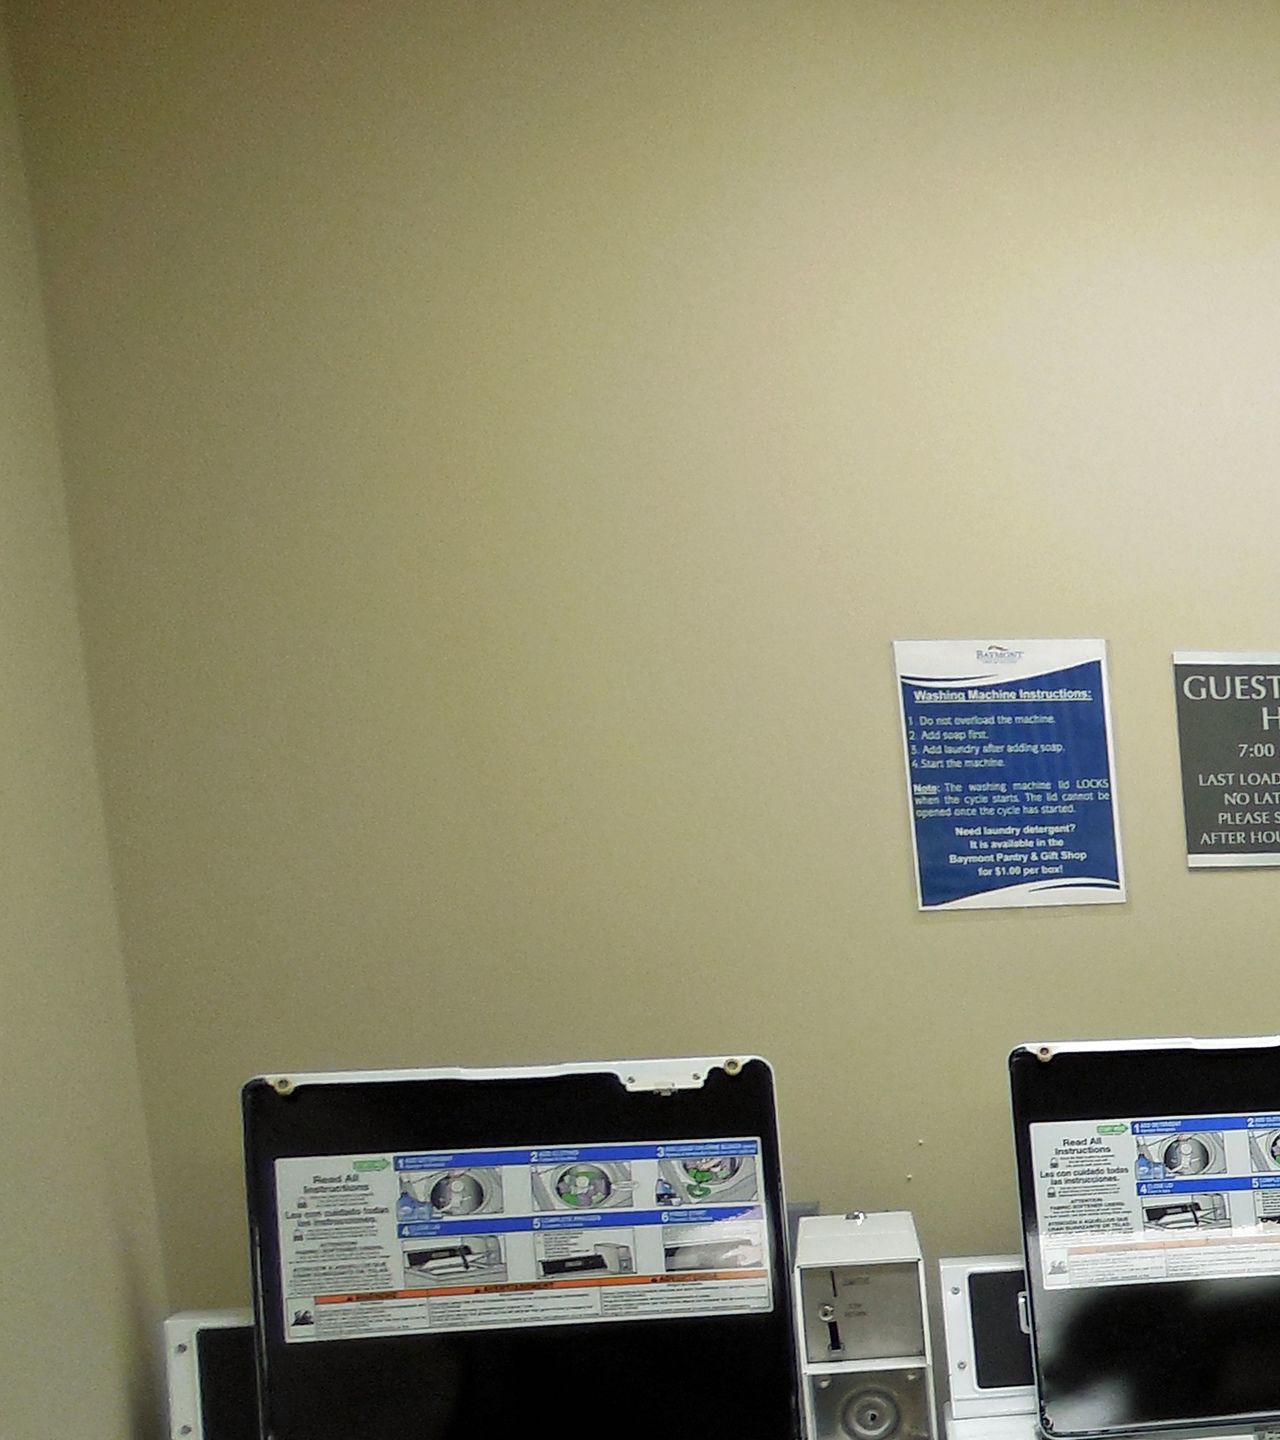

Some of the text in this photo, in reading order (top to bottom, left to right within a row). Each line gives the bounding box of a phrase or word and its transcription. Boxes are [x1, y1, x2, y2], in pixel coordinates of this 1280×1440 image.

[913, 688, 1092, 701] Washing Machine Instructions:
[919, 716, 934, 726] Do
[936, 717, 953, 725] not
[954, 715, 995, 725] overload
[997, 715, 1013, 724] the
[921, 730, 941, 740] Add
[942, 731, 967, 741] soap
[922, 744, 942, 754] Add
[943, 744, 980, 755] laundry
[982, 743, 1005, 753] after
[1006, 743, 1039, 754] adding
[1238, 743, 1275, 758] 7:00
[920, 759, 944, 768] Start
[946, 759, 962, 768] the
[1198, 773, 1235, 787] LAST
[913, 779, 1110, 795] Note: The washing machine lid LOCKS
[915, 796, 940, 805] when
[944, 795, 960, 804] the
[963, 796, 989, 806] cycle
[1025, 793, 1042, 802] The
[1046, 792, 1058, 801] lid
[1061, 792, 1094, 801] cannot
[1097, 791, 1110, 800] be
[1224, 792, 1250, 806] NO
[915, 808, 952, 819] opened
[953, 808, 977, 816] once
[979, 807, 995, 816] the
[996, 806, 1020, 817] cycle
[1022, 805, 1039, 814] has
[1217, 811, 1270, 826] PLEASE
[954, 824, 1077, 836] Need laundry detergent?
[969, 838, 1064, 849] It is available in the
[1199, 831, 1246, 845] AFTER
[949, 850, 1088, 865] Baymont Pantry & Gift Shop
[977, 867, 993, 876] for
[1022, 867, 1040, 877] per
[1041, 865, 1063, 874] box!
[1247, 1117, 1254, 1128] 2
[1133, 1123, 1140, 1134] 1
[1063, 1137, 1102, 1147] Read All
[530, 1151, 538, 1162] 2
[656, 1147, 665, 1158] 3
[1055, 1146, 1111, 1156] Instructions
[313, 1174, 359, 1185] Read All
[1251, 1177, 1259, 1188] 5
[1139, 1183, 1147, 1194] 4
[661, 1211, 669, 1222] 6
[533, 1217, 541, 1229] 5
[402, 1226, 410, 1236] 4
